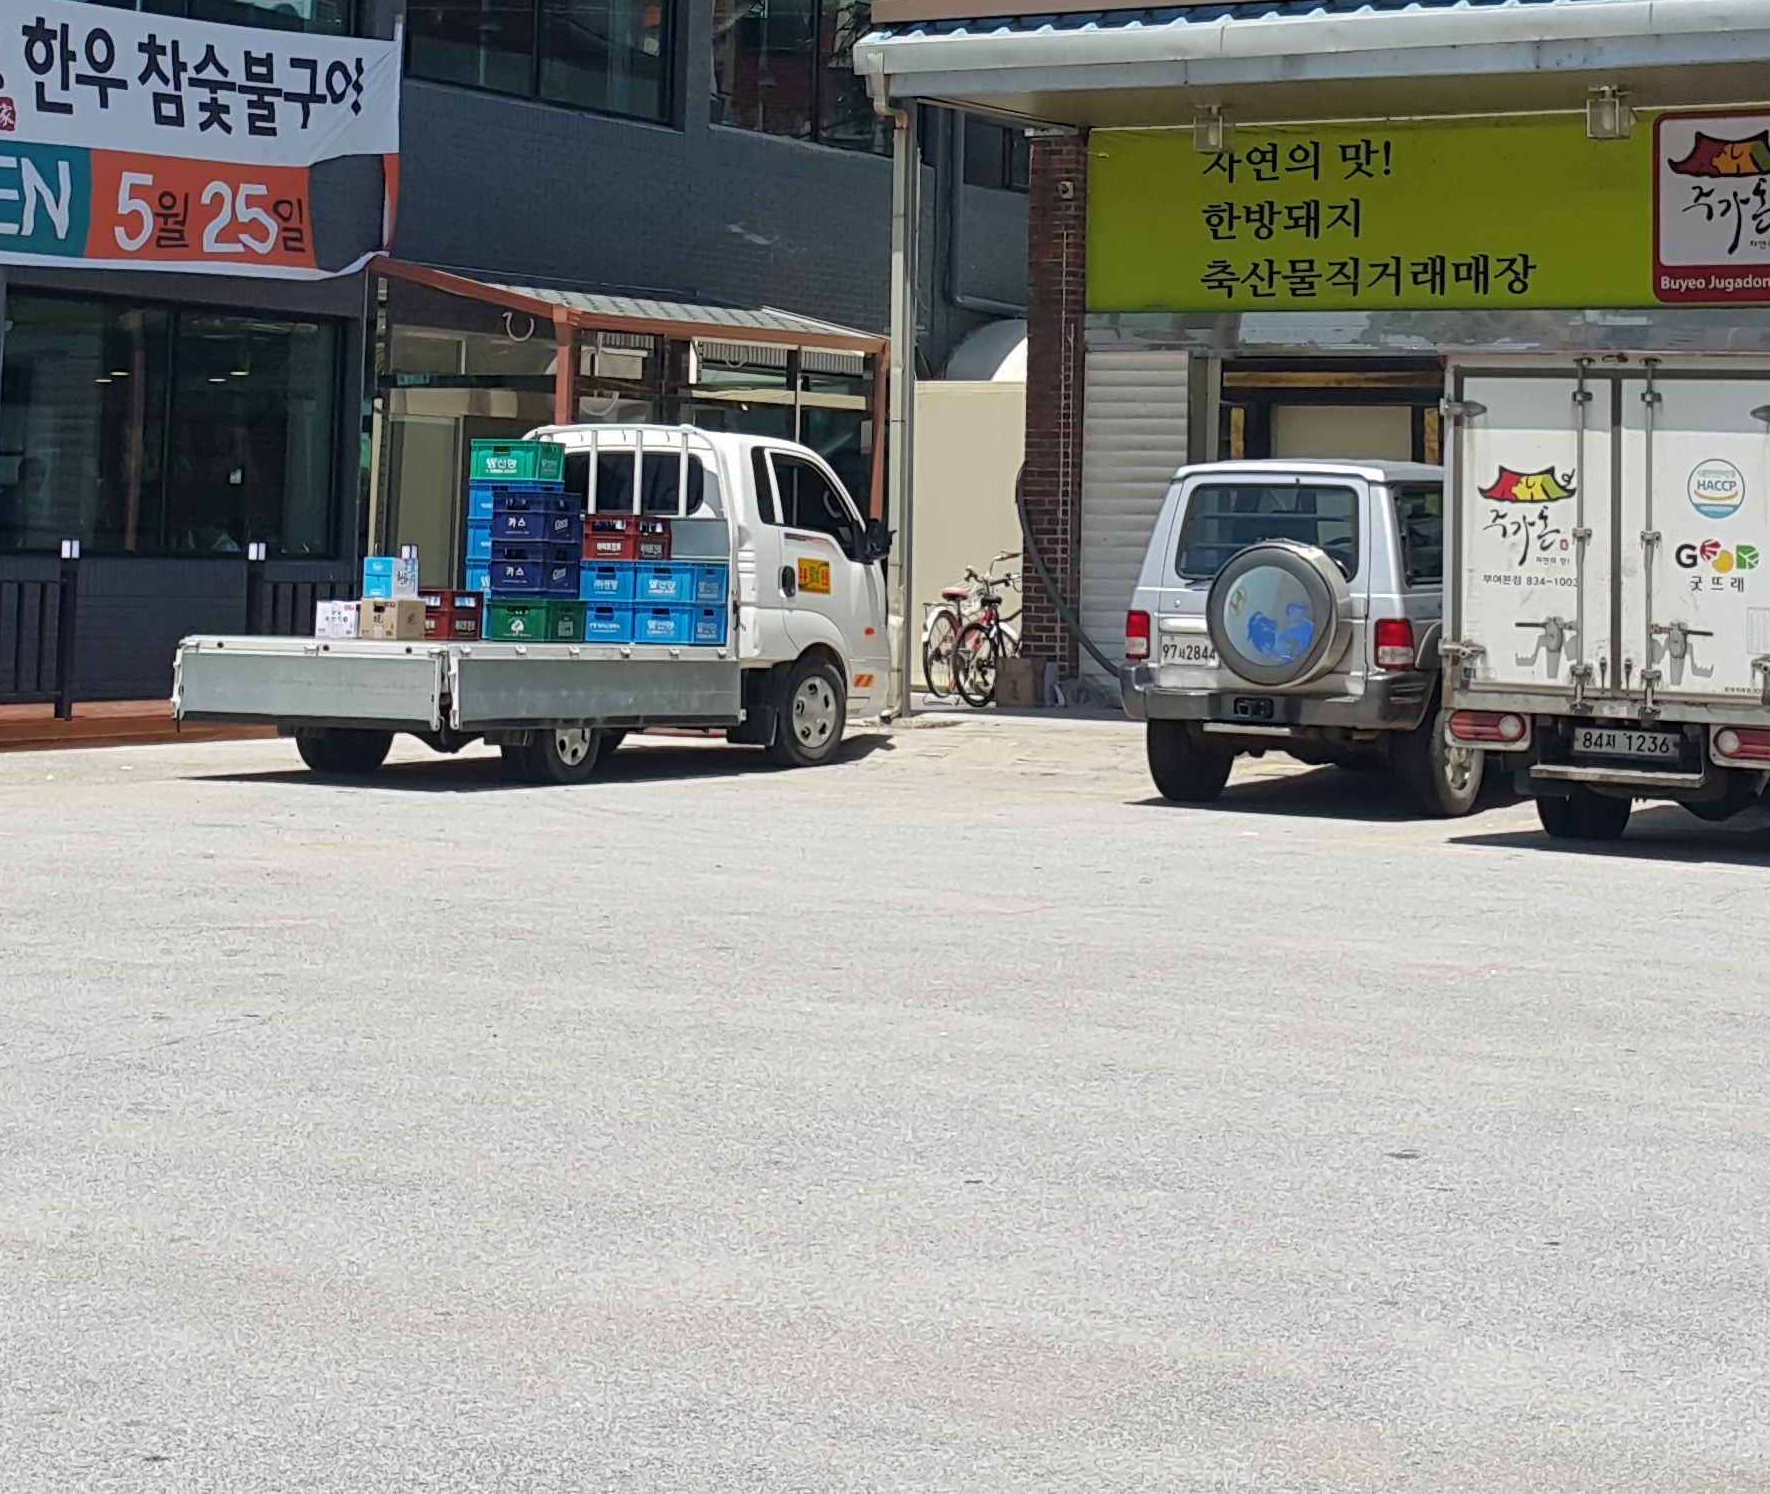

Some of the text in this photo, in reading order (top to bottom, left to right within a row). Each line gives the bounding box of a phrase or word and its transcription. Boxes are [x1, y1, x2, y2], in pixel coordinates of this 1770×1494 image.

[22, 17, 127, 115] 한우
[1339, 139, 1392, 180] 맛!
[114, 171, 307, 255] 5월 25일
[1202, 198, 1361, 240] 한방돼지
[1200, 253, 1537, 298] 축산물직거래매장
[1660, 276, 1706, 292] Buyeo
[1697, 480, 1736, 491] HACCP
[1483, 573, 1522, 587] 부여본점
[1625, 733, 1670, 754] 1236
